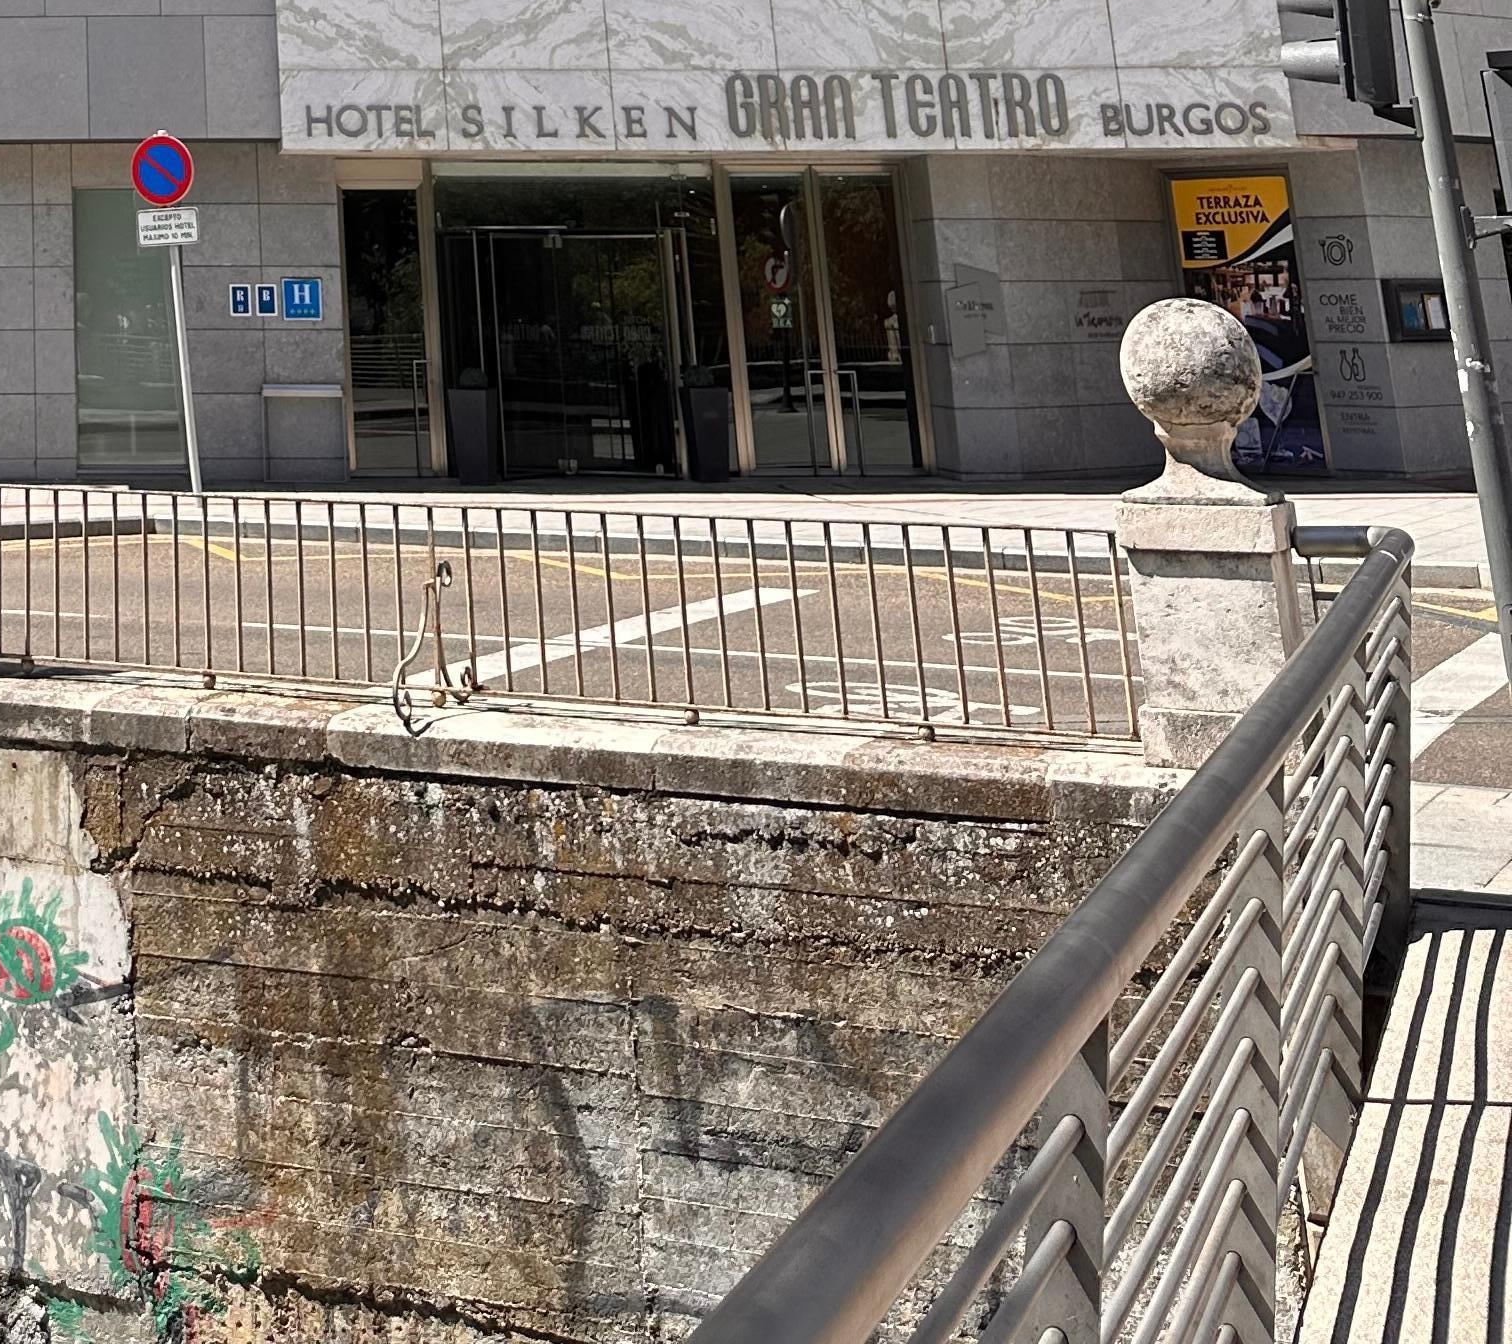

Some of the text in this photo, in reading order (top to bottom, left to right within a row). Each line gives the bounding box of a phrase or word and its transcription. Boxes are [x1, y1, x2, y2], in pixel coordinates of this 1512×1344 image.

[304, 71, 1271, 141] HOTEL SILKEN GRAN TEATRO BURGOS
[1196, 194, 1263, 209] TERRAZA
[1195, 211, 1270, 225] EXCLUSIVA
[236, 289, 245, 302] R
[262, 289, 271, 302] B
[292, 283, 312, 305] H
[1319, 294, 1356, 306] COME
[1339, 306, 1363, 316] BIEN
[1325, 316, 1367, 325] AL MEJOR
[1328, 324, 1365, 334] PRECIO
